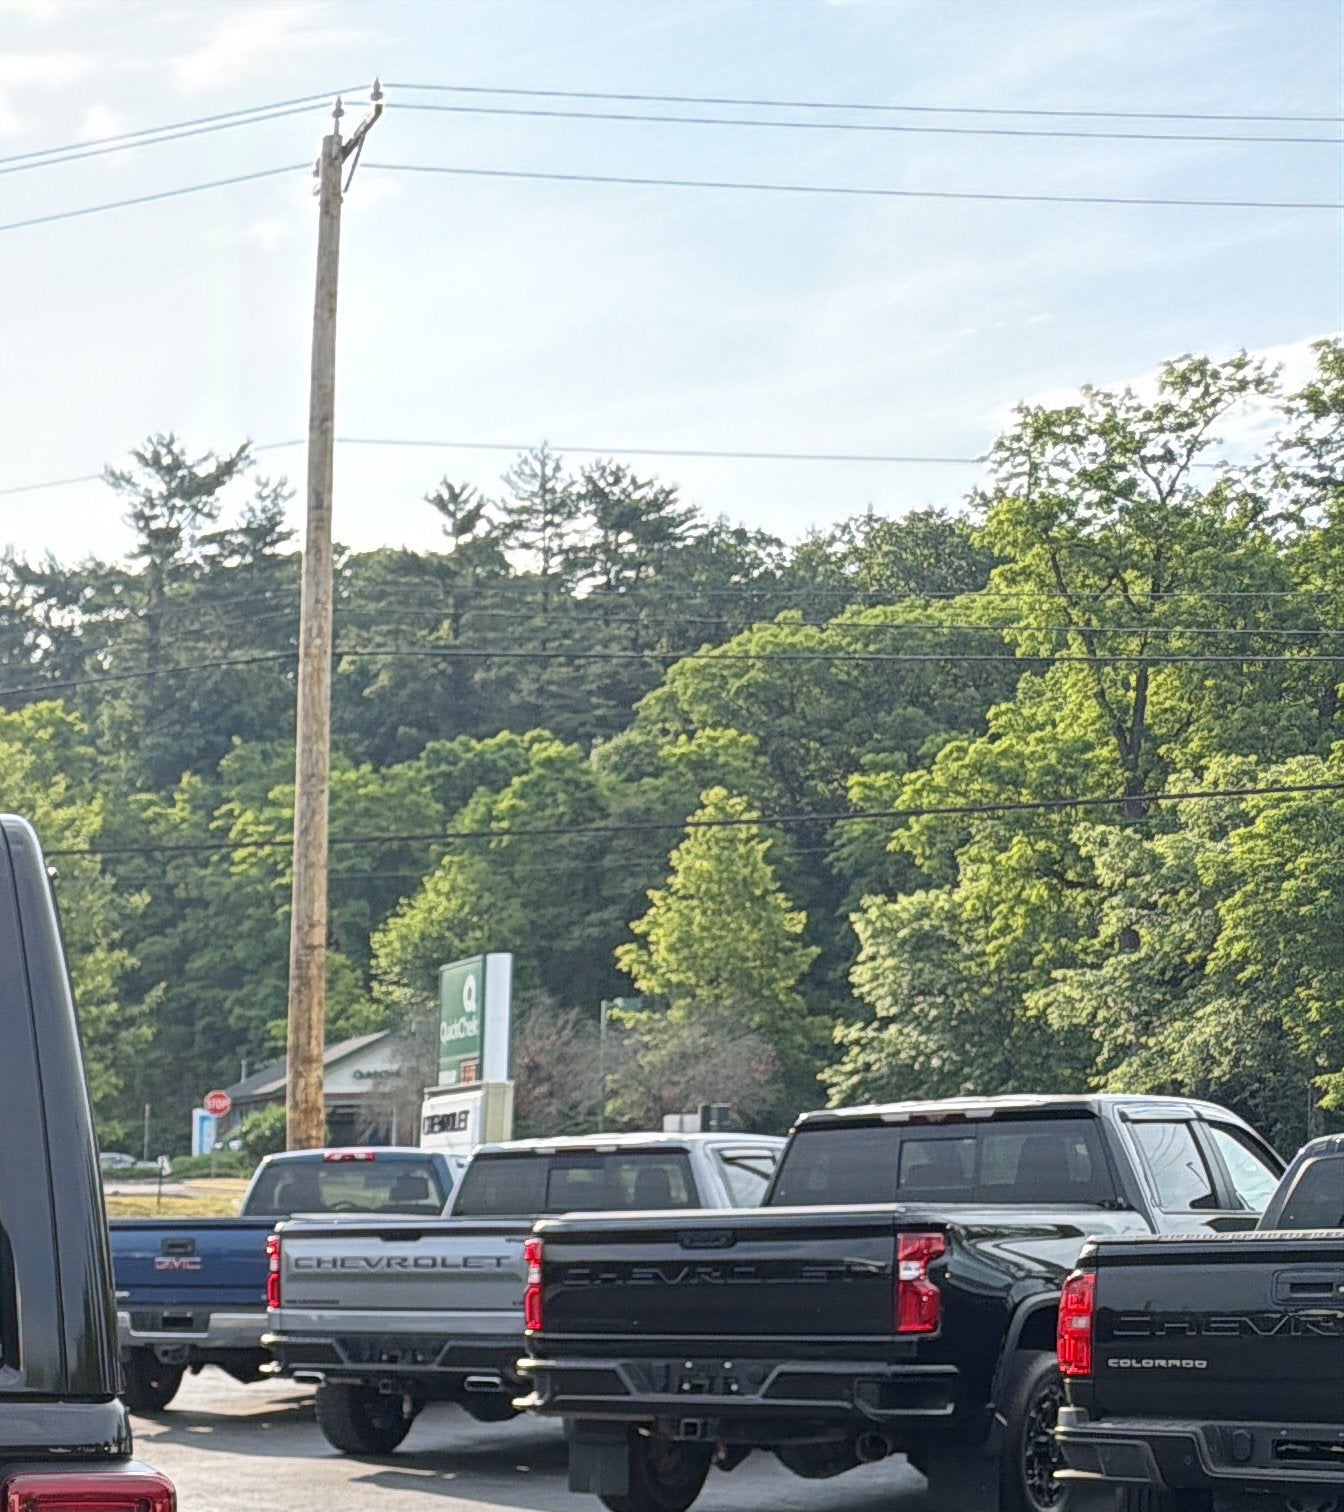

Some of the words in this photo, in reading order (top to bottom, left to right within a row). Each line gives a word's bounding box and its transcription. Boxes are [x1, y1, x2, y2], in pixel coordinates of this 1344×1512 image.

[206, 1098, 230, 1111] STOP
[154, 1256, 202, 1270] GMC
[294, 1255, 511, 1270] CHEVROLET
[1107, 1358, 1209, 1370] COLORADO
